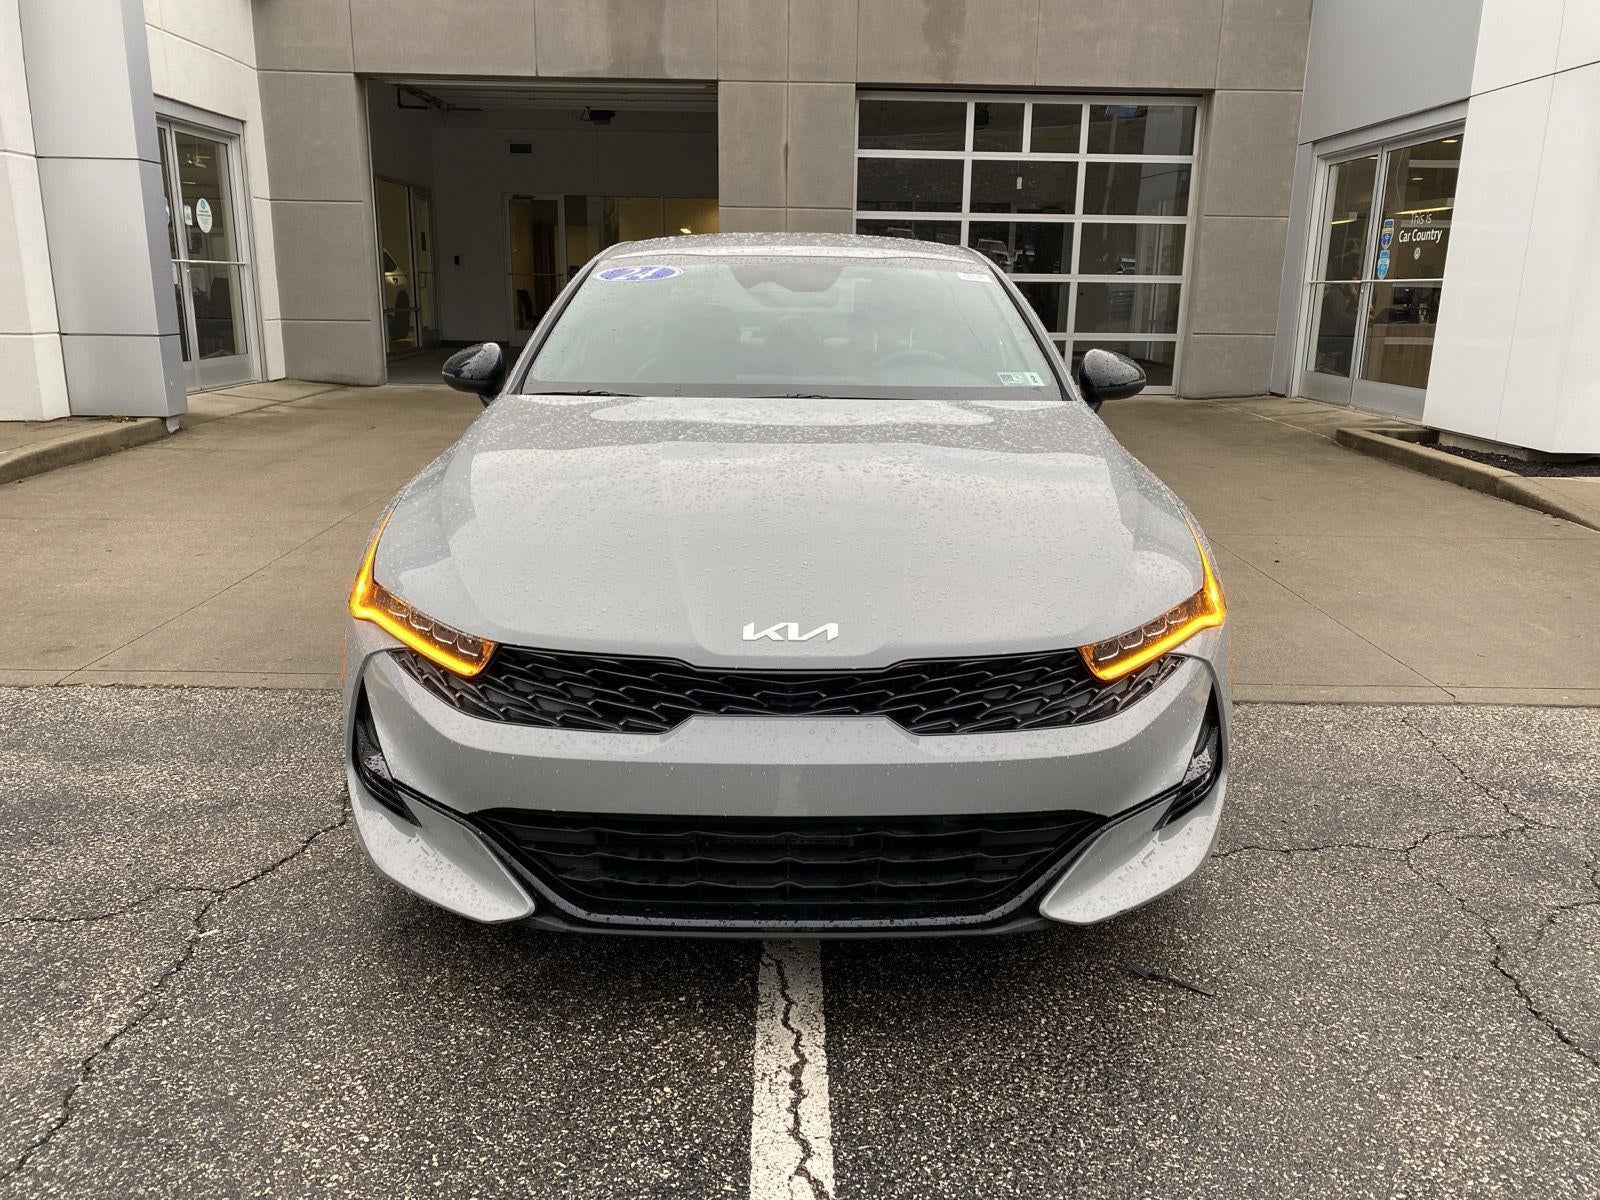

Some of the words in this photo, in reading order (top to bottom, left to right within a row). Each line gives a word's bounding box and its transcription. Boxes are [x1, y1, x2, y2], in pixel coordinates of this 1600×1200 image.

[1410, 212, 1424, 225] This
[1425, 212, 1432, 224] is
[1398, 230, 1411, 243] Car
[1411, 228, 1443, 244] Country
